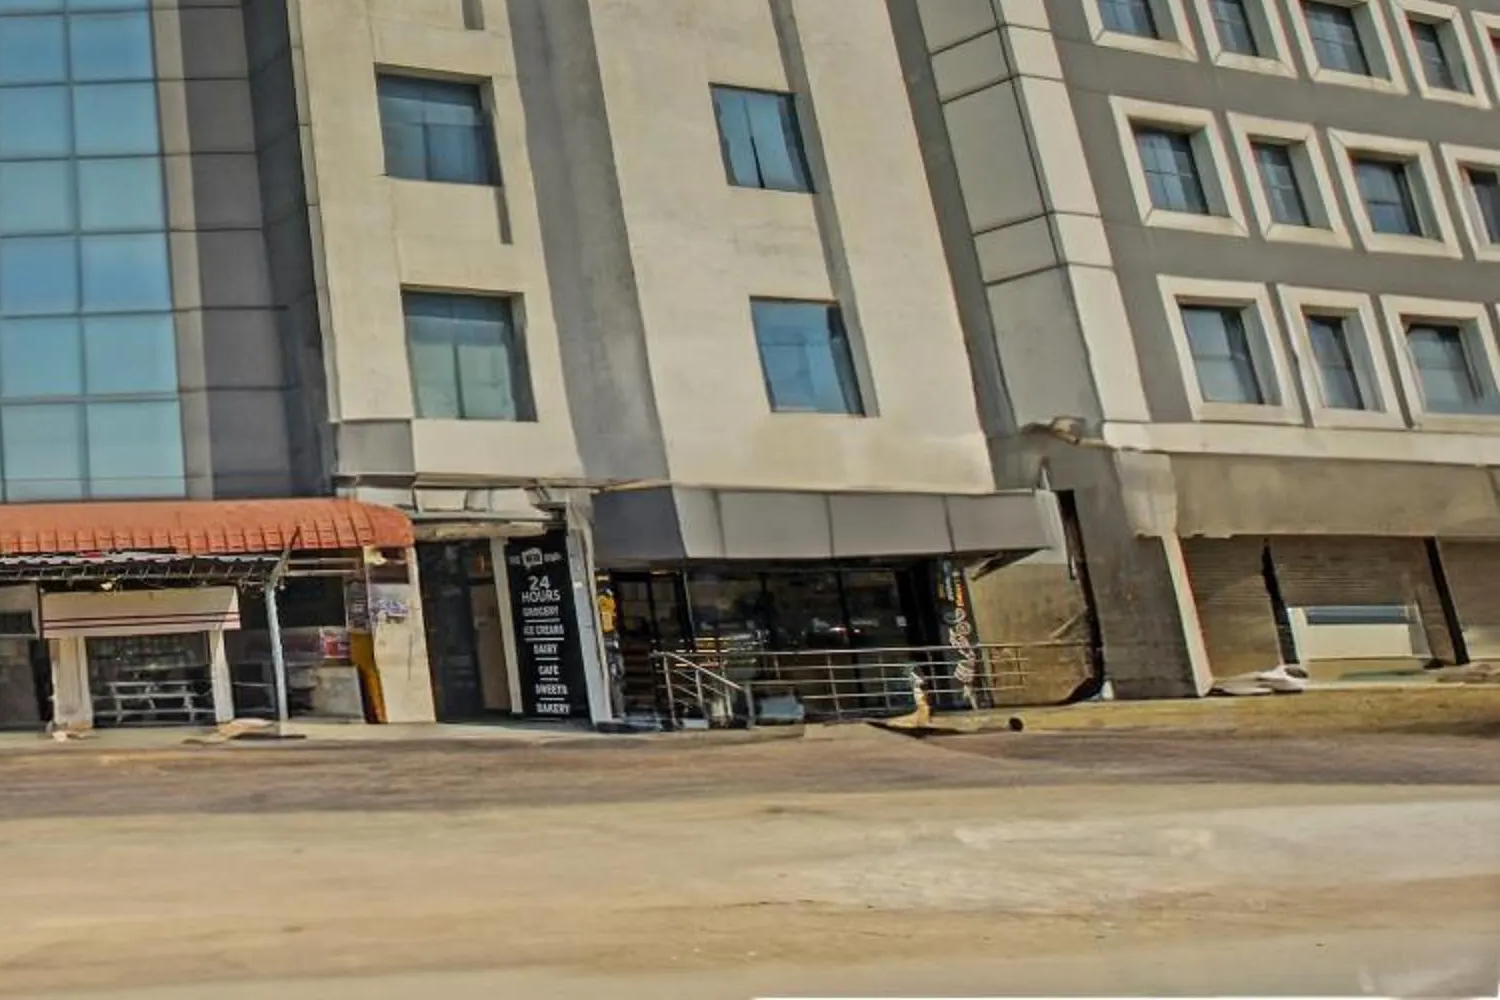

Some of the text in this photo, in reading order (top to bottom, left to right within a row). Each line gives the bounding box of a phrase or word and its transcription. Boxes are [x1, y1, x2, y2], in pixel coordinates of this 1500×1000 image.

[527, 575, 551, 592] 24
[521, 589, 561, 604] HOURS
[536, 702, 571, 714] BAKERY
